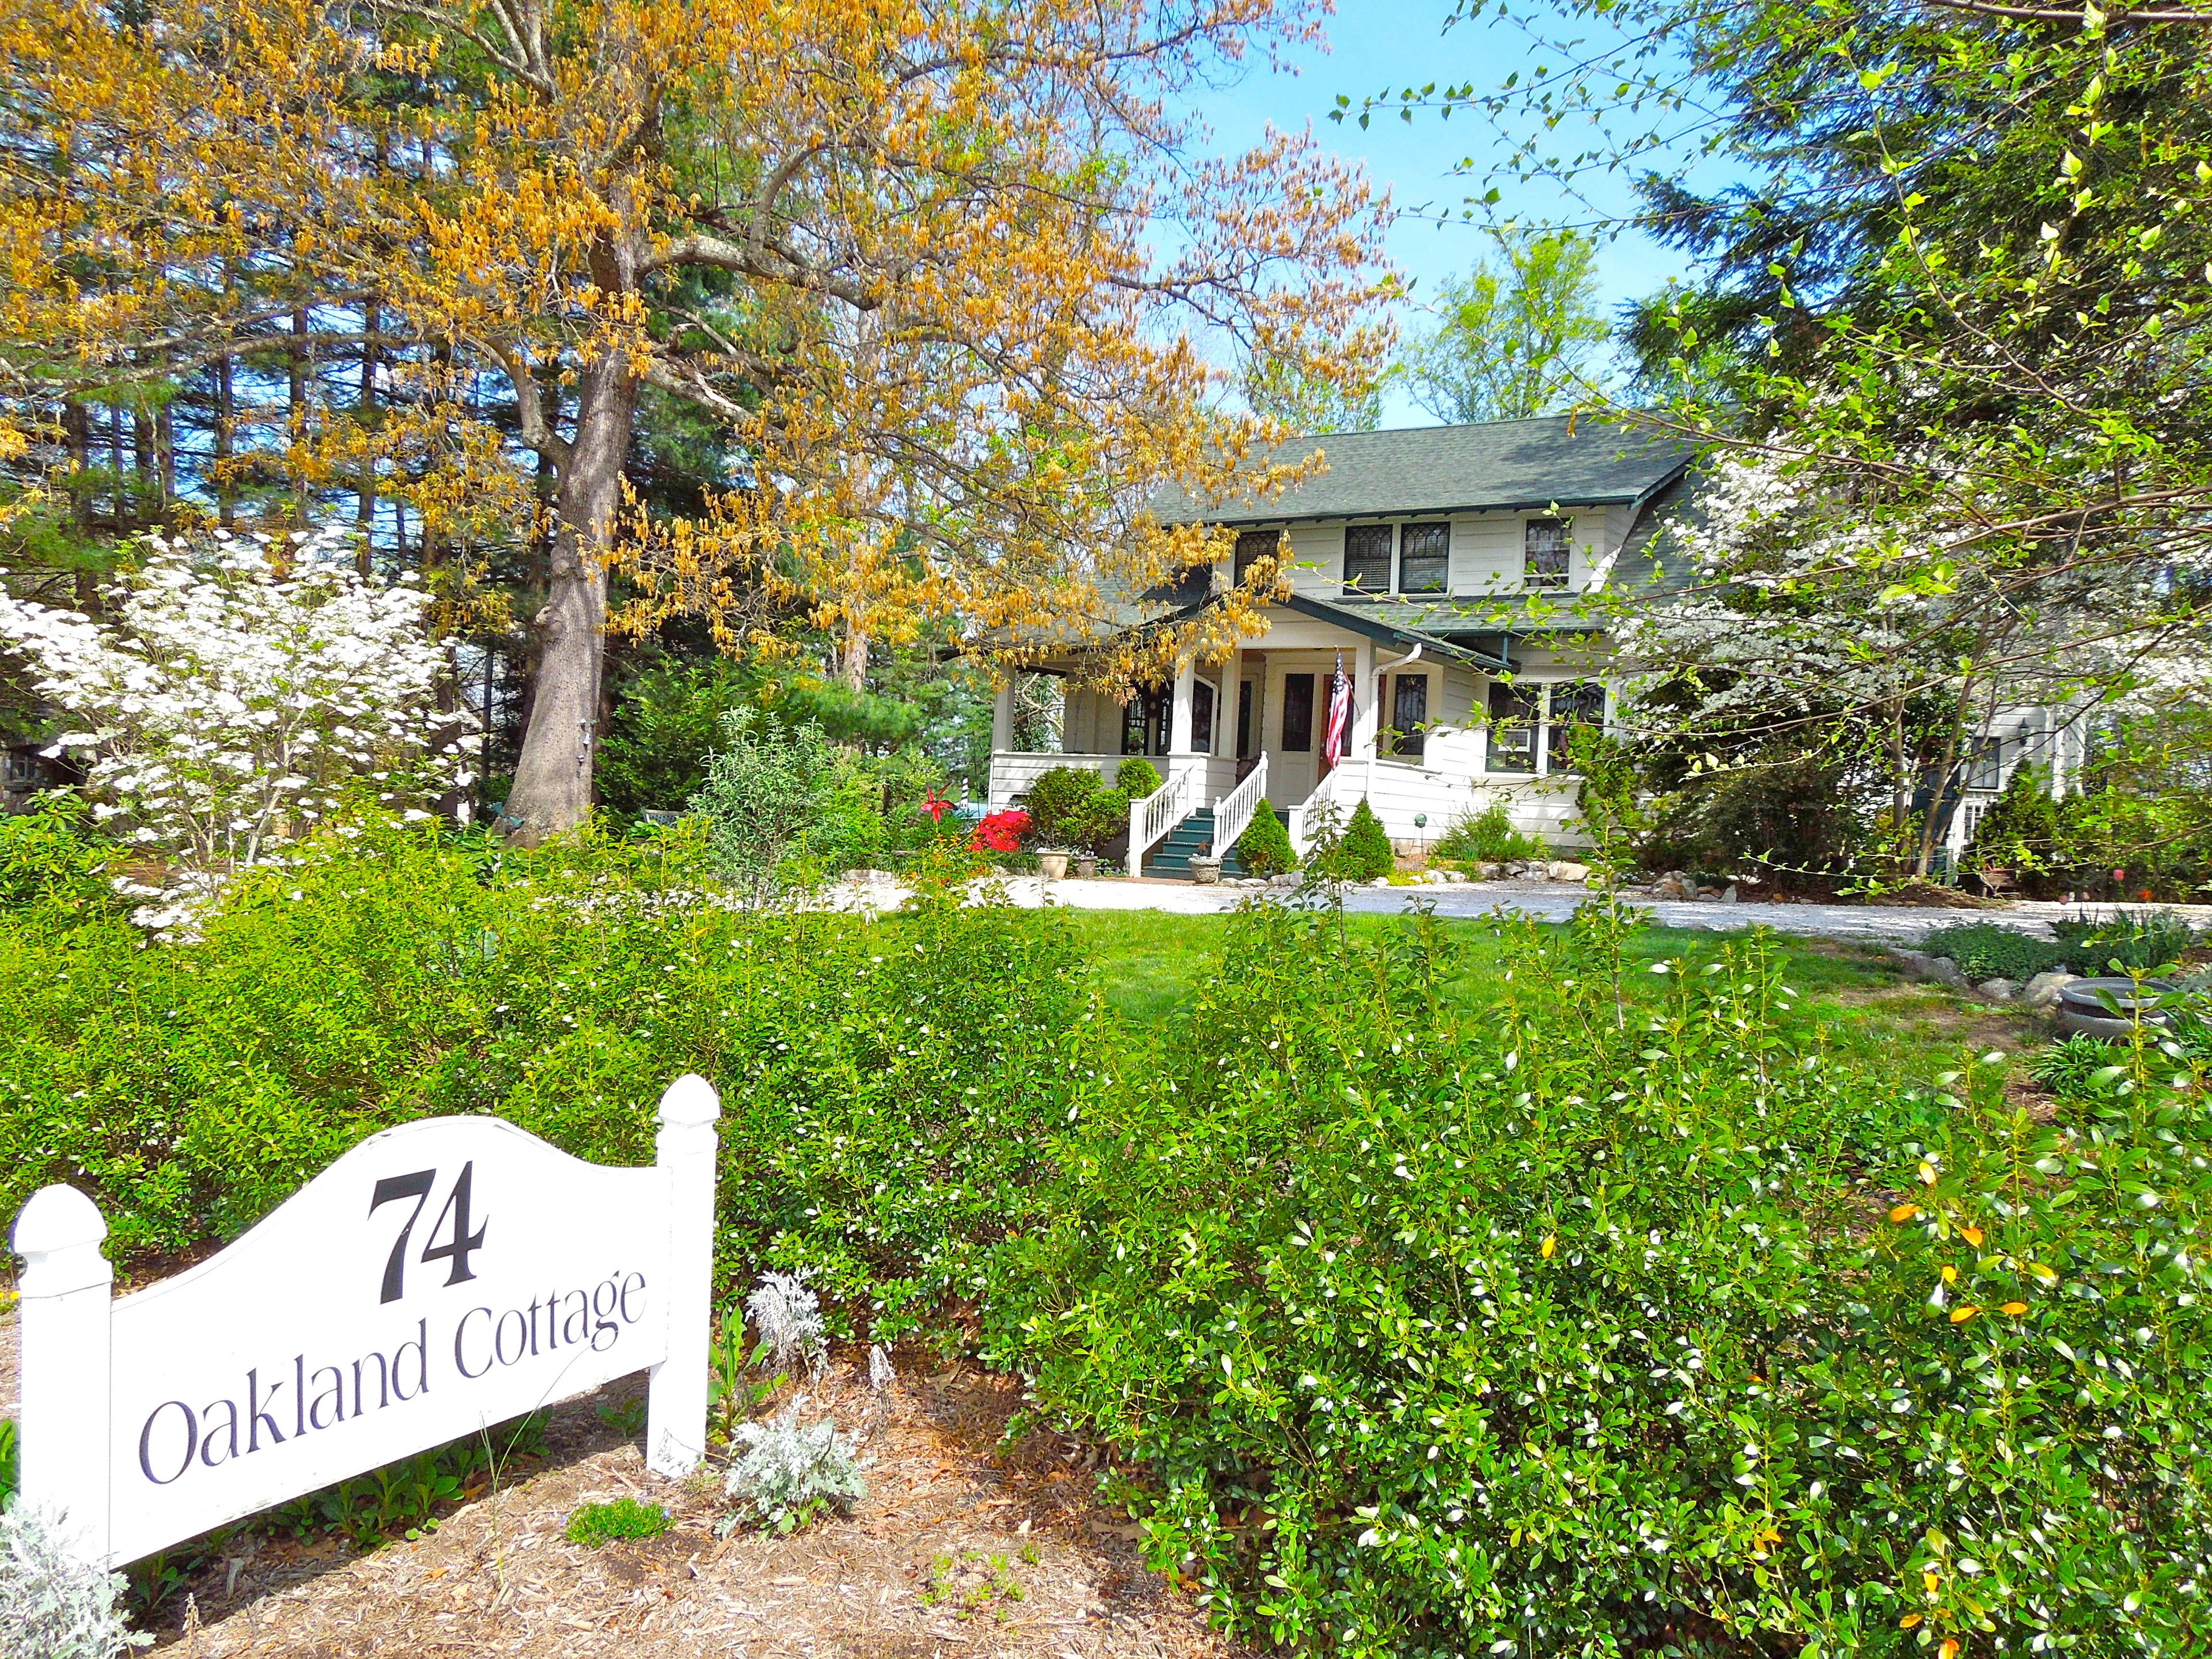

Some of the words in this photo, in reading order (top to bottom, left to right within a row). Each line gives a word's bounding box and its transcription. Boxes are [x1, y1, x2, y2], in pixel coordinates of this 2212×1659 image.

[368, 1160, 489, 1305] 74
[139, 1317, 429, 1484] Oakland
[454, 1270, 646, 1378] Cottage
